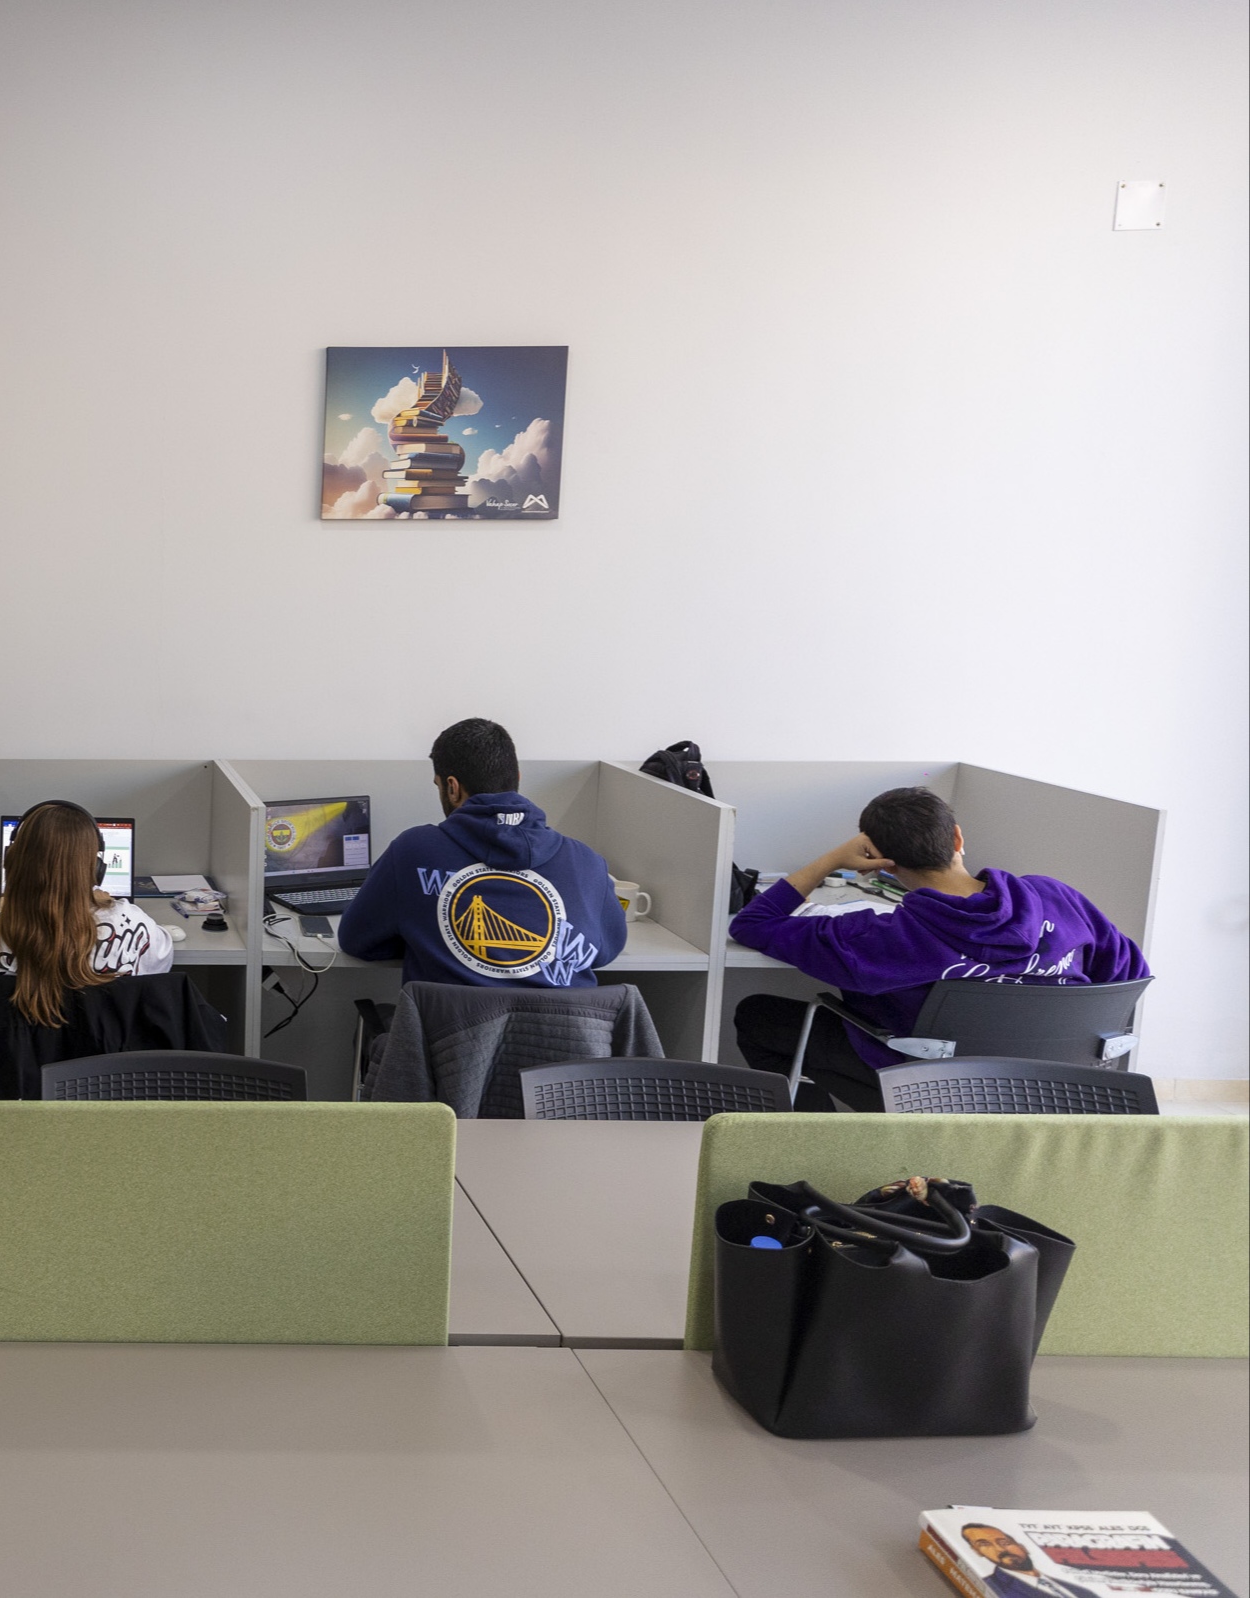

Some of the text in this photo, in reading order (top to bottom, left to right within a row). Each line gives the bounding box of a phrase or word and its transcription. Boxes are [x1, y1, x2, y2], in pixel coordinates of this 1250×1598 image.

[452, 870, 475, 888] GOLDEN
[533, 878, 554, 899] GOLDEN
[552, 898, 561, 915] STATE
[442, 891, 473, 962] GOLDEN STATE WARRIORS
[476, 962, 511, 974] WARRIORS
[511, 966, 530, 974] STATE
